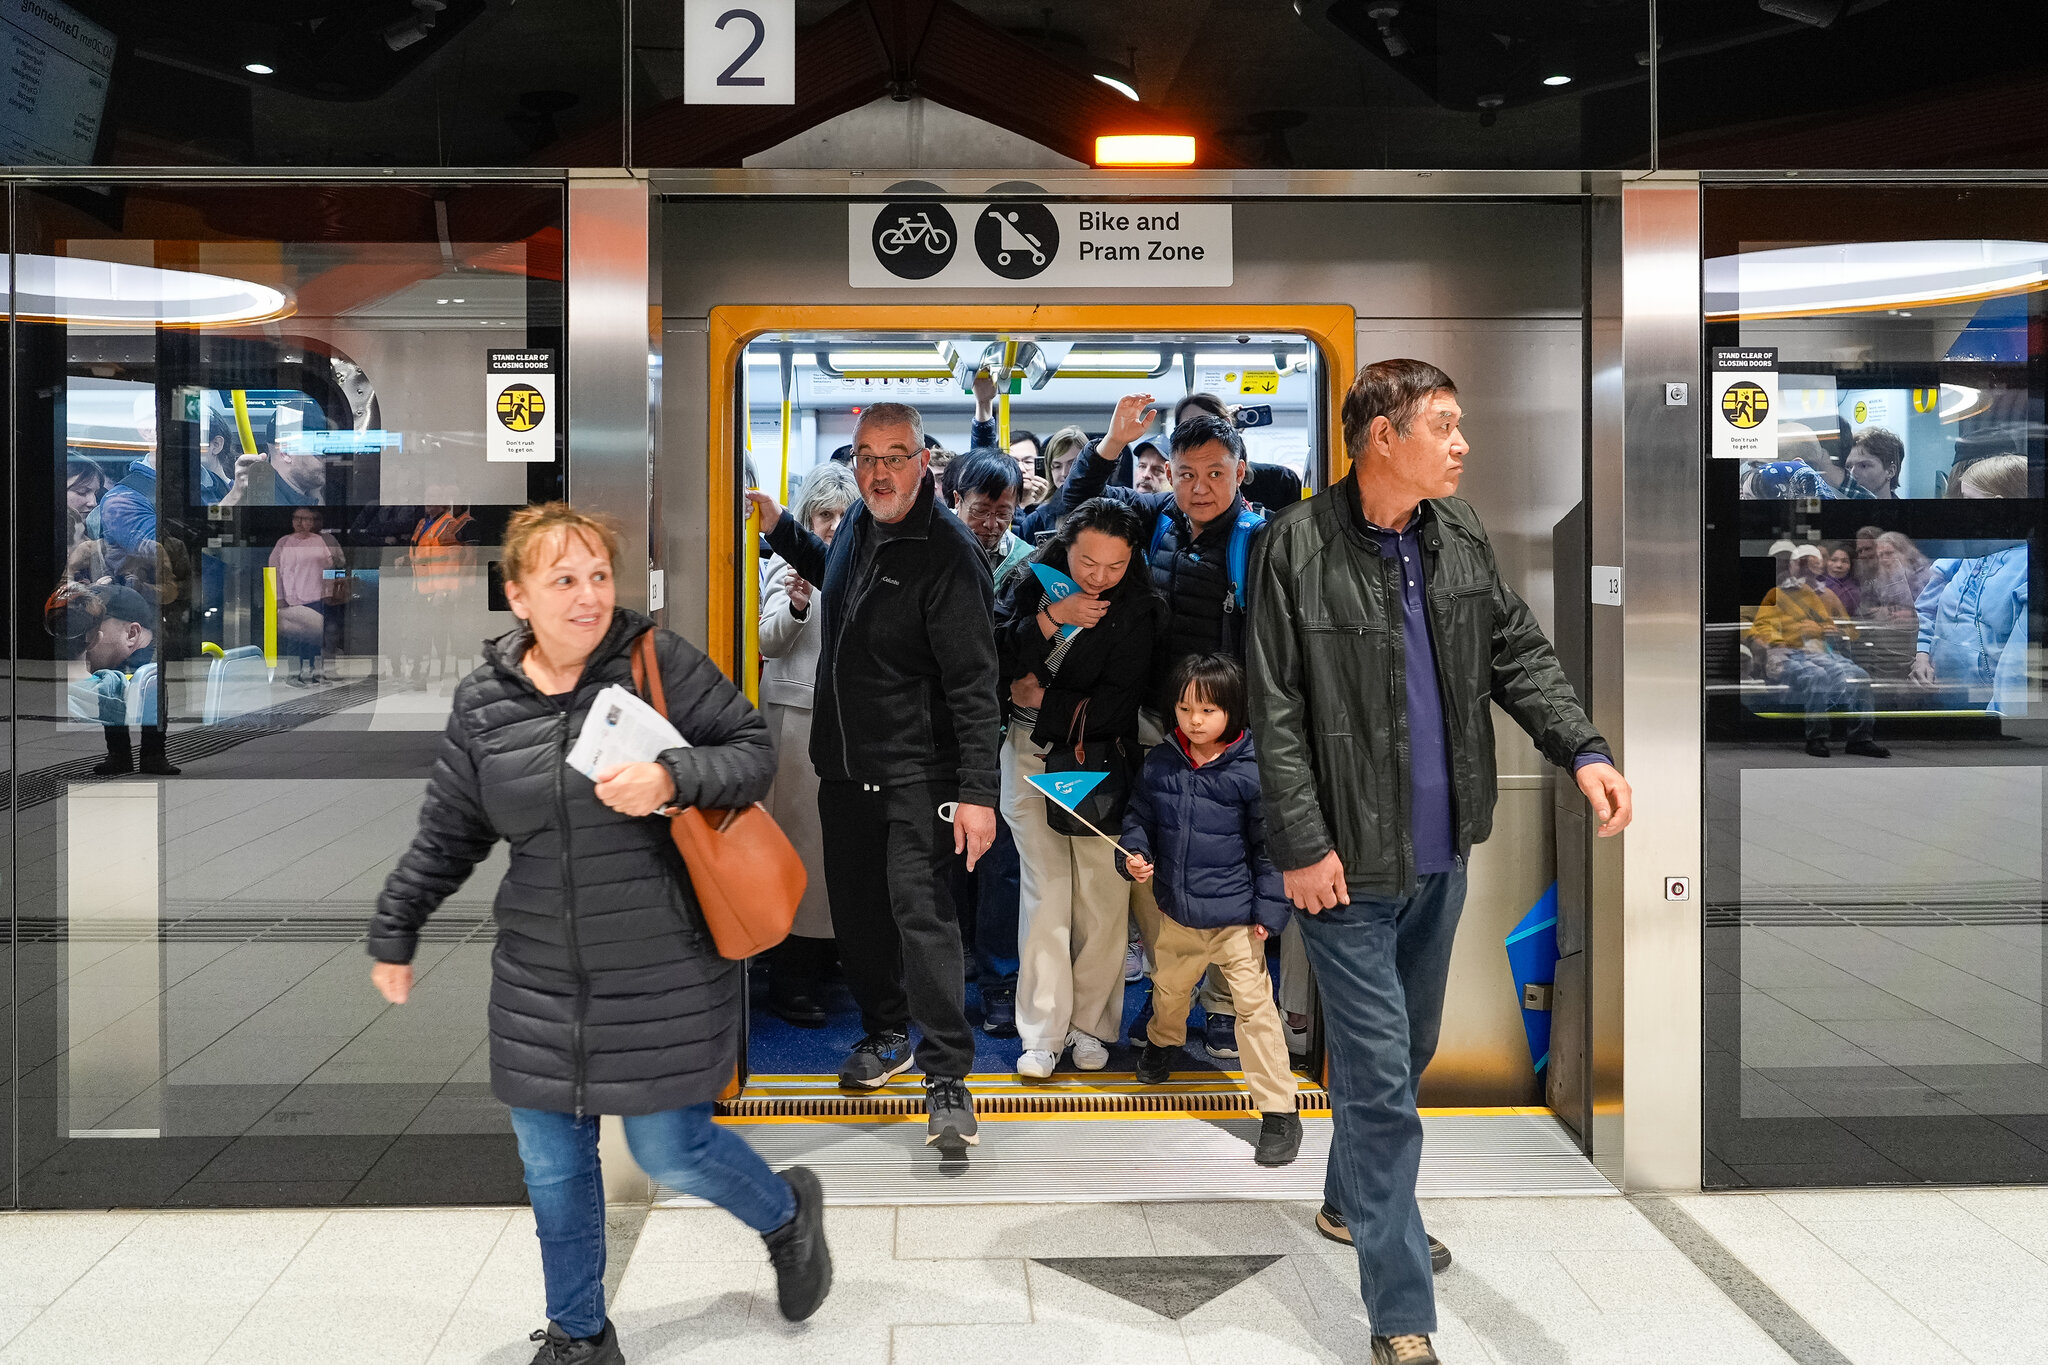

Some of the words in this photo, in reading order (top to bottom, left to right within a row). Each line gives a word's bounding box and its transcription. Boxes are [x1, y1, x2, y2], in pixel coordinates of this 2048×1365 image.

[715, 8, 766, 87] 2
[1079, 211, 1130, 233] Bike
[1136, 211, 1180, 233] and
[1079, 241, 1140, 262] Pram
[1147, 241, 1205, 262] Zone
[652, 584, 657, 599] 13
[1609, 579, 1619, 594] 13
